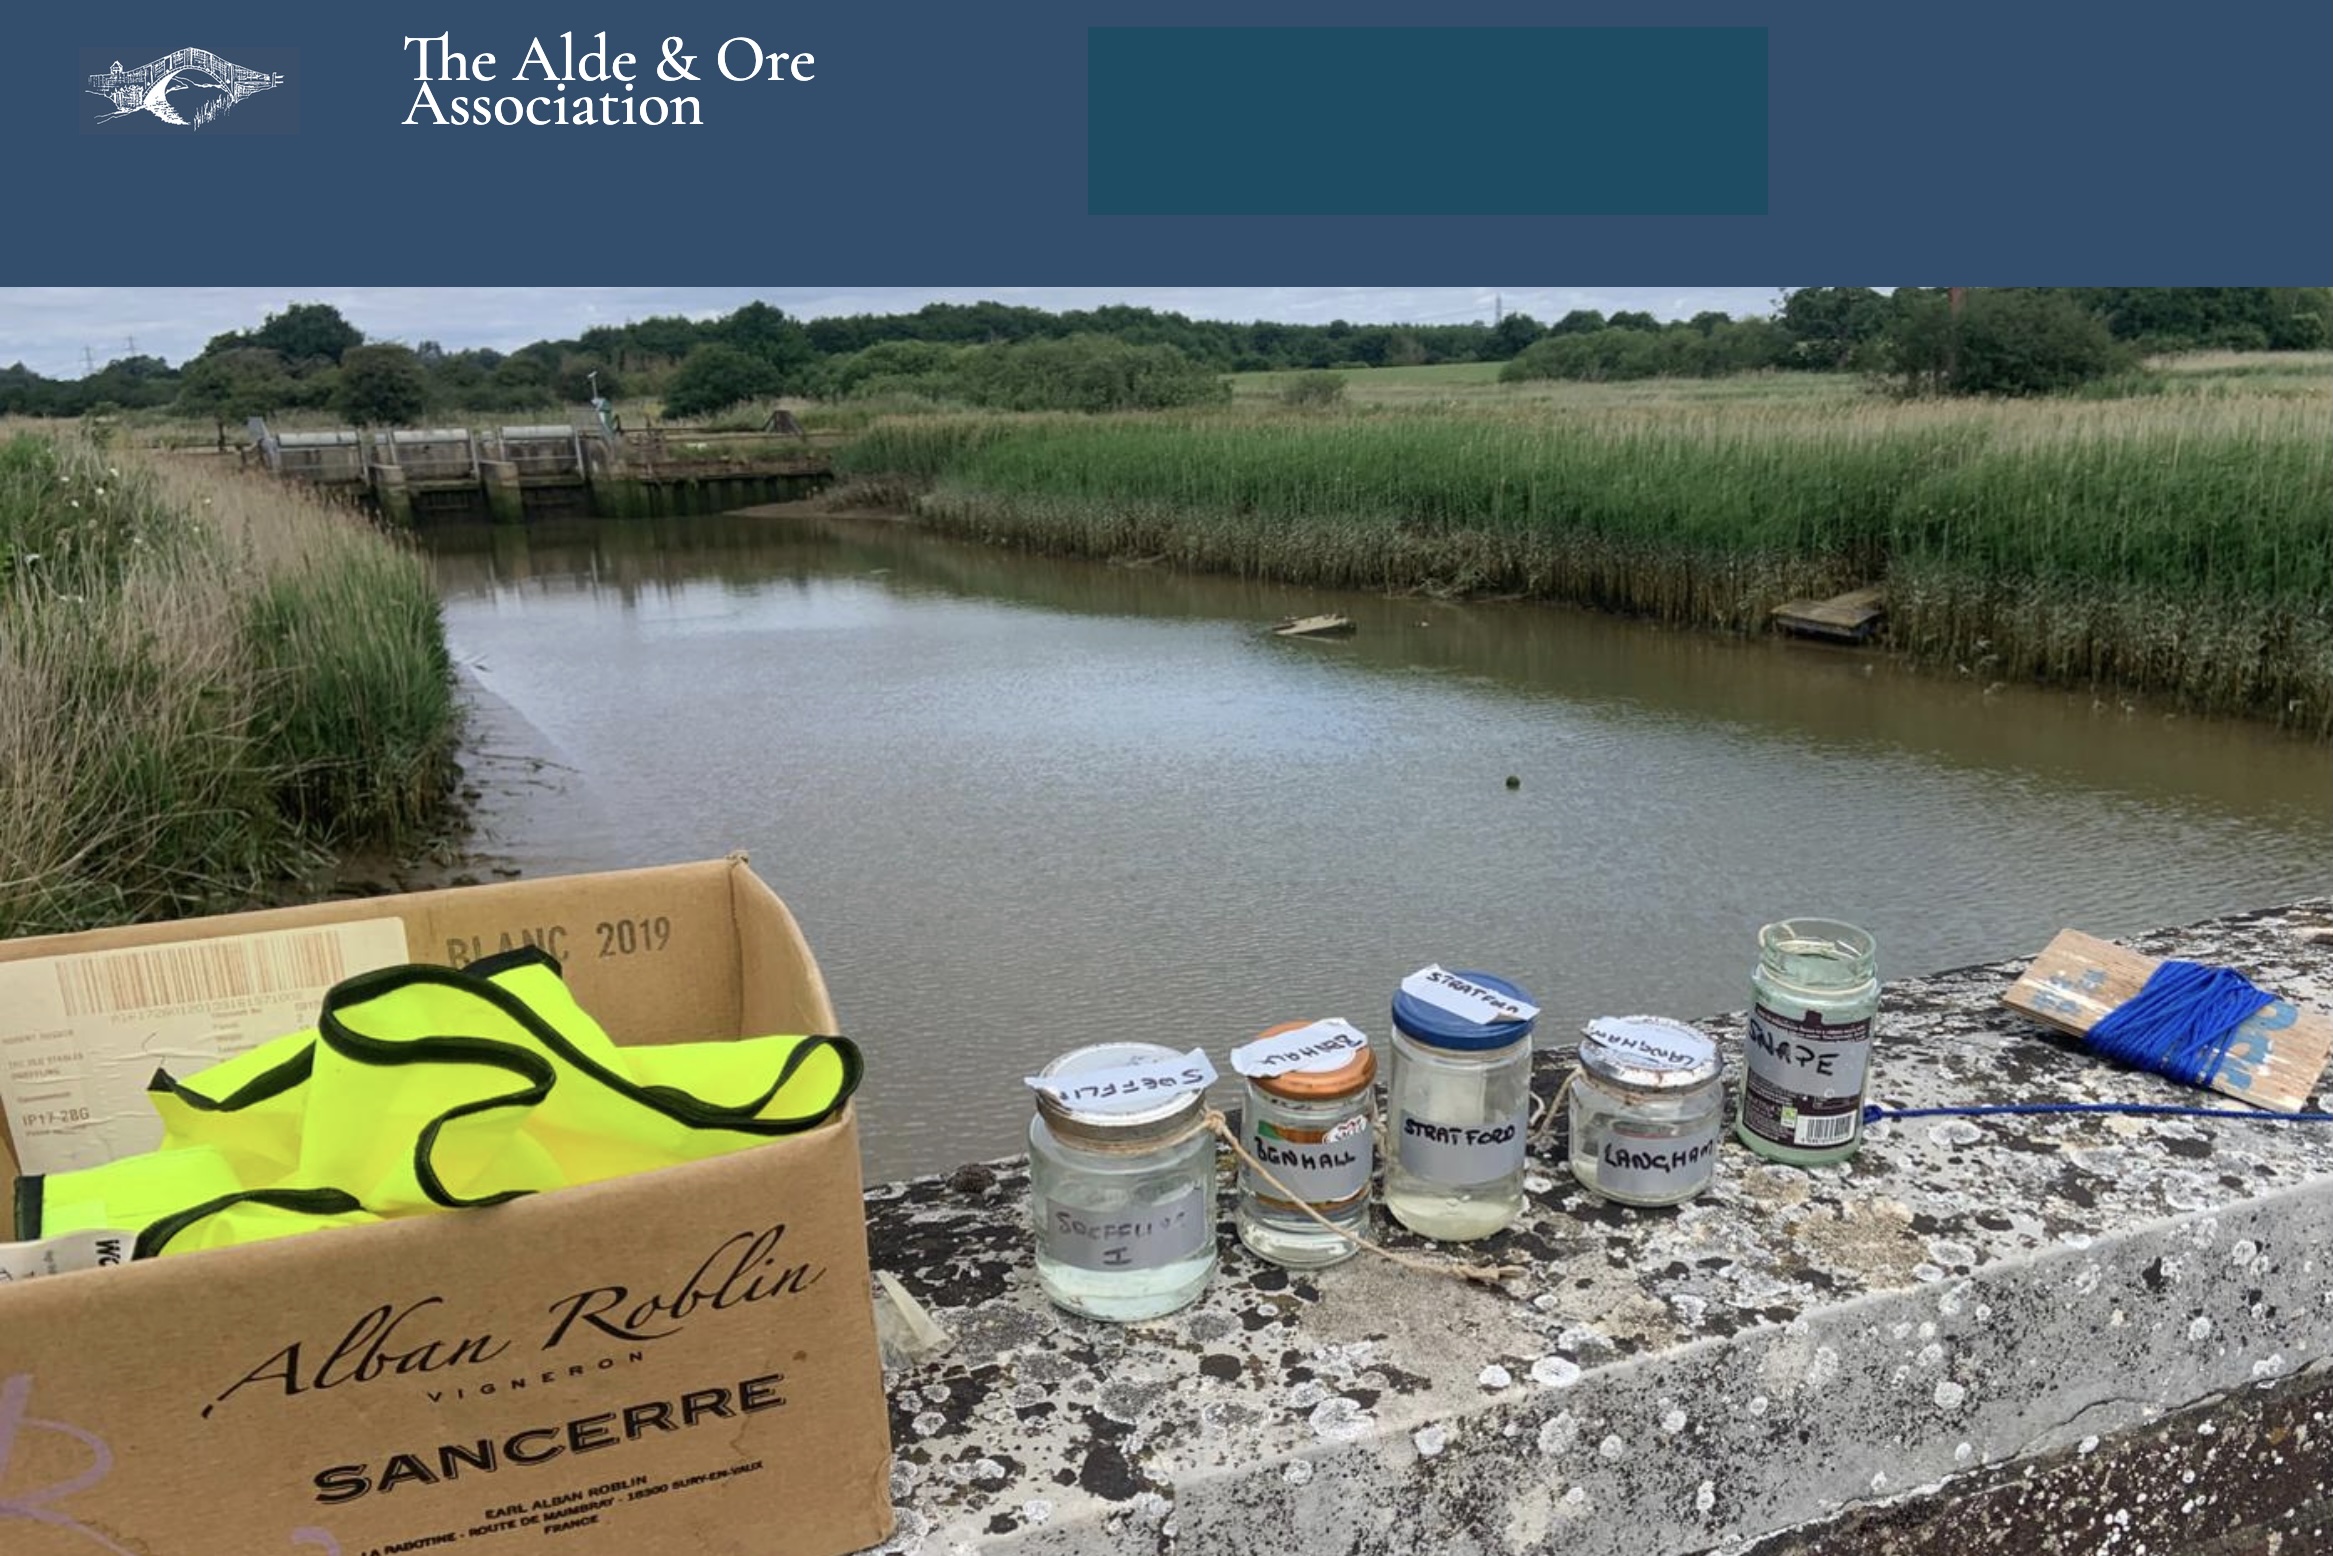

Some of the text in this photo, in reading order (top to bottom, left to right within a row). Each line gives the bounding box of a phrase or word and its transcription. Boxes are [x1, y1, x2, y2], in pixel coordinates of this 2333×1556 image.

[596, 916, 671, 958] 2019
[1749, 1018, 1840, 1076] SNAPE
[1403, 1117, 1517, 1145] STRATFORD
[1604, 1139, 1714, 1174] LANGHAM
[201, 1224, 827, 1419] Alban Roblin
[427, 1351, 643, 1403] VIGNERON
[313, 1373, 787, 1505] SANCERRE
[468, 1518, 517, 1537] ROUTE
[520, 1514, 539, 1526] DE
[543, 1497, 615, 1521] MAIMBRAY
[485, 1475, 648, 1519] EARL ALBAN ROBLIN
[543, 1514, 600, 1534] FRANCE
